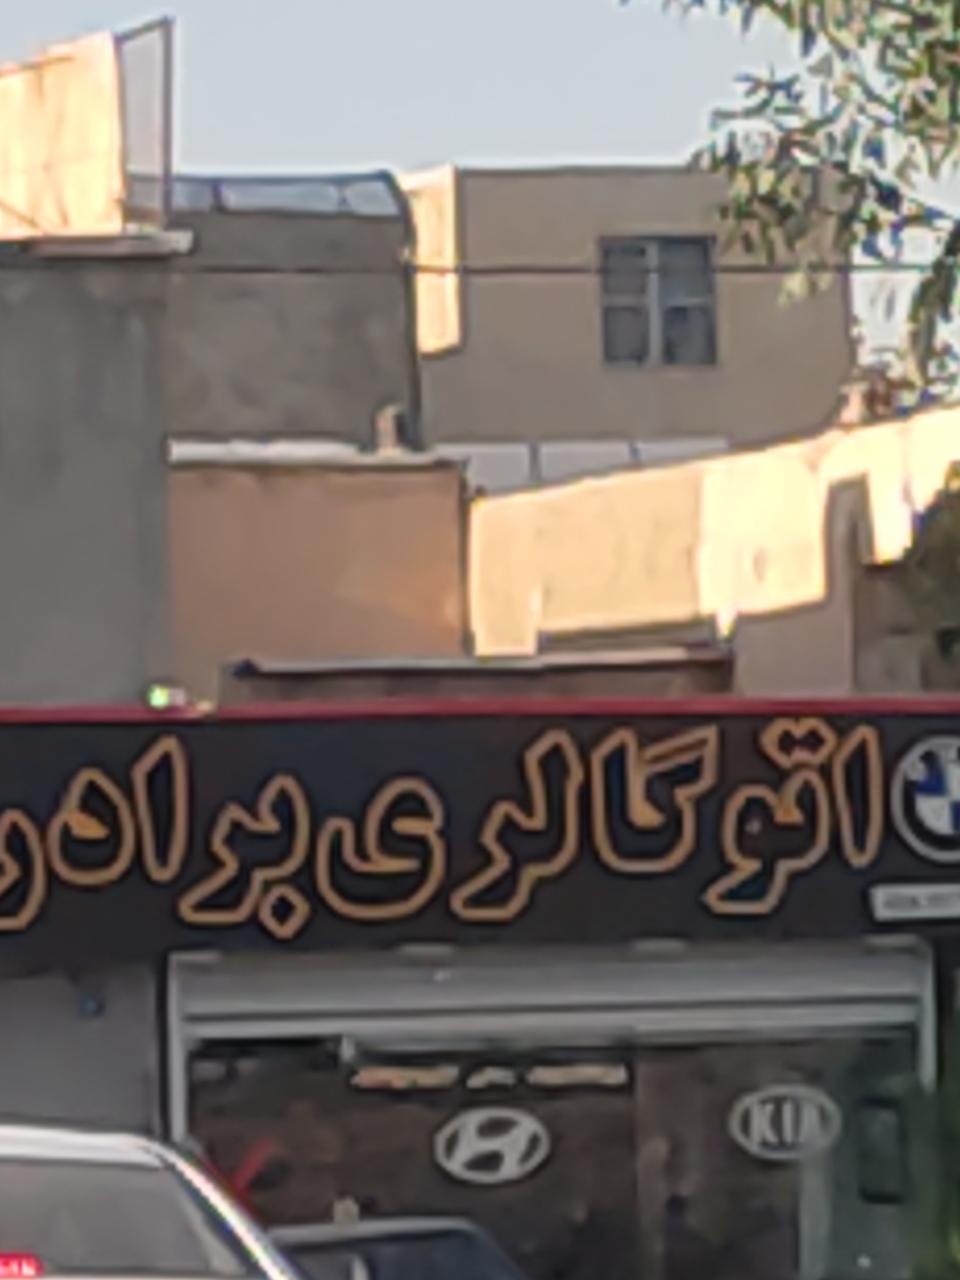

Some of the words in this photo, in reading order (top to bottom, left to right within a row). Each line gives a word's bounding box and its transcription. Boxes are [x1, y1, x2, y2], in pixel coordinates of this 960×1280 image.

[316, 726, 720, 920] گالری
[704, 717, 883, 915] اتو
[750, 1098, 823, 1144] KIA
